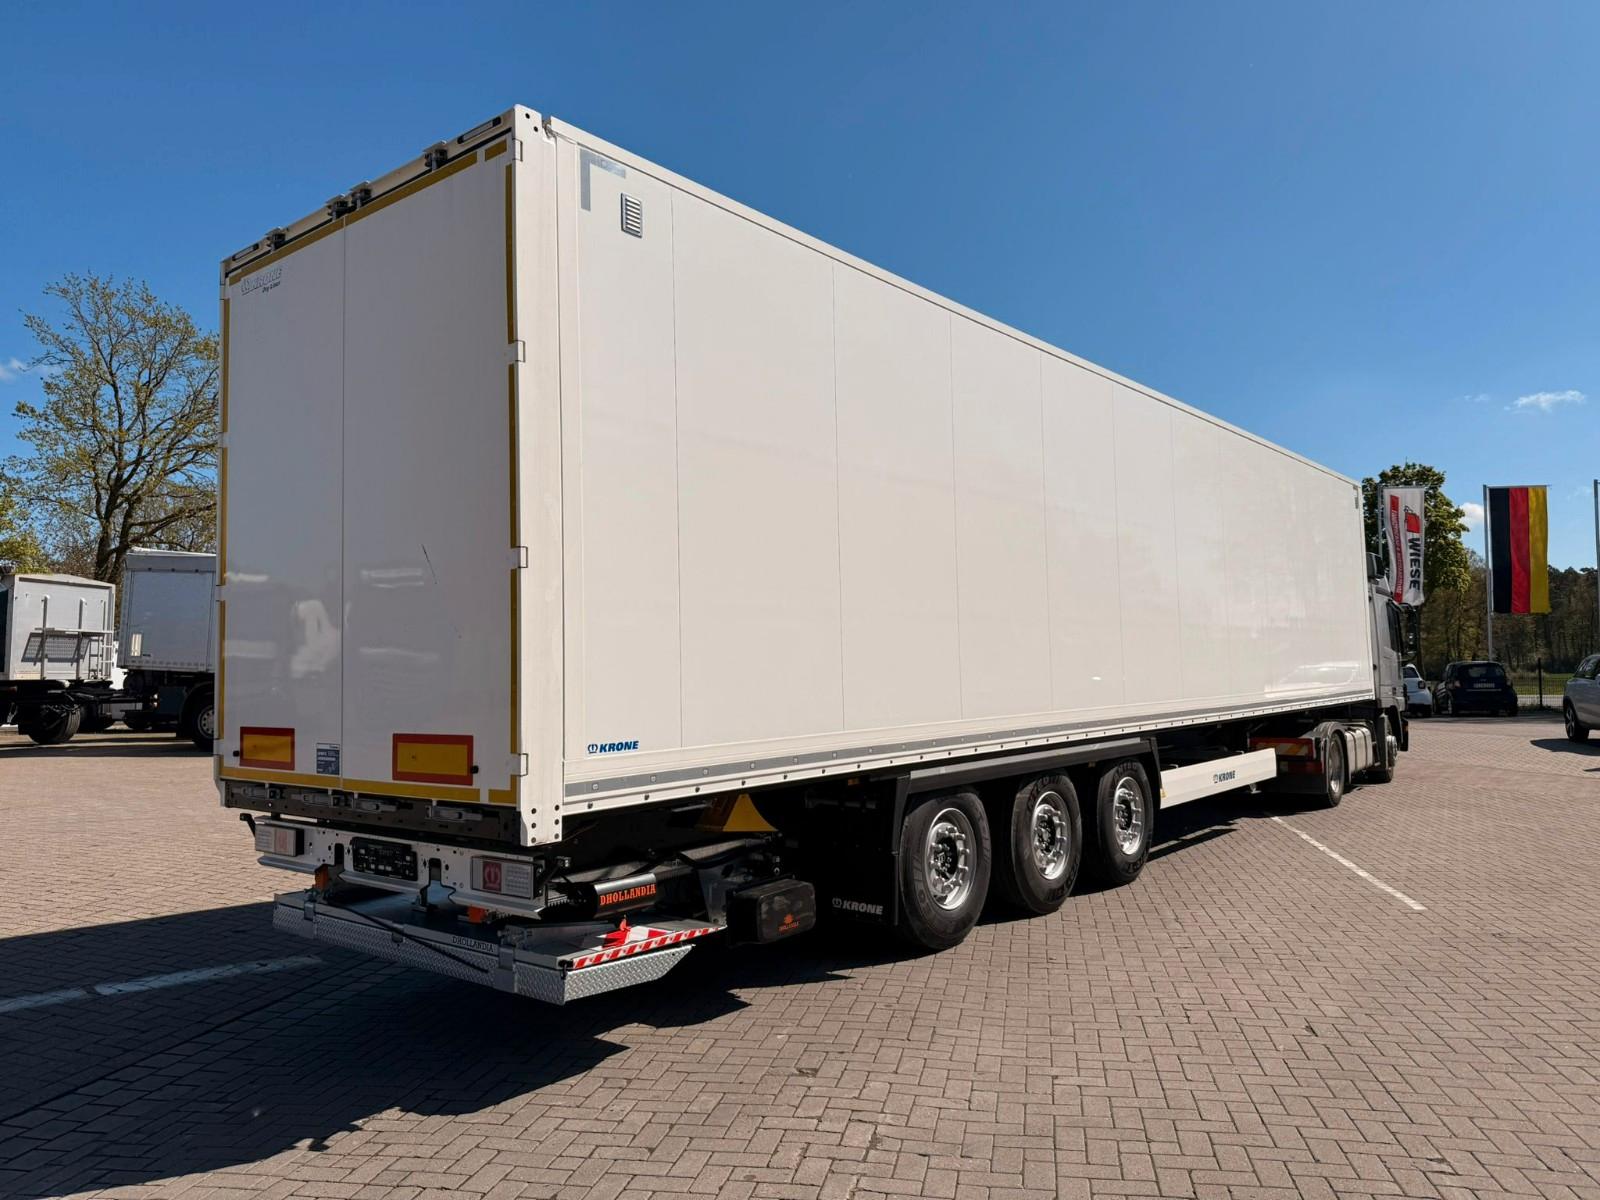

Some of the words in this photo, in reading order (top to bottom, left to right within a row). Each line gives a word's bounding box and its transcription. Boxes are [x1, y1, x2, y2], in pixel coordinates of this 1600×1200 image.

[1408, 537, 1421, 591] WIESE
[599, 740, 639, 753] KRONE
[1219, 770, 1236, 782] KRONE
[600, 883, 657, 906] DHOLLANDIA
[843, 900, 884, 915] KRONE
